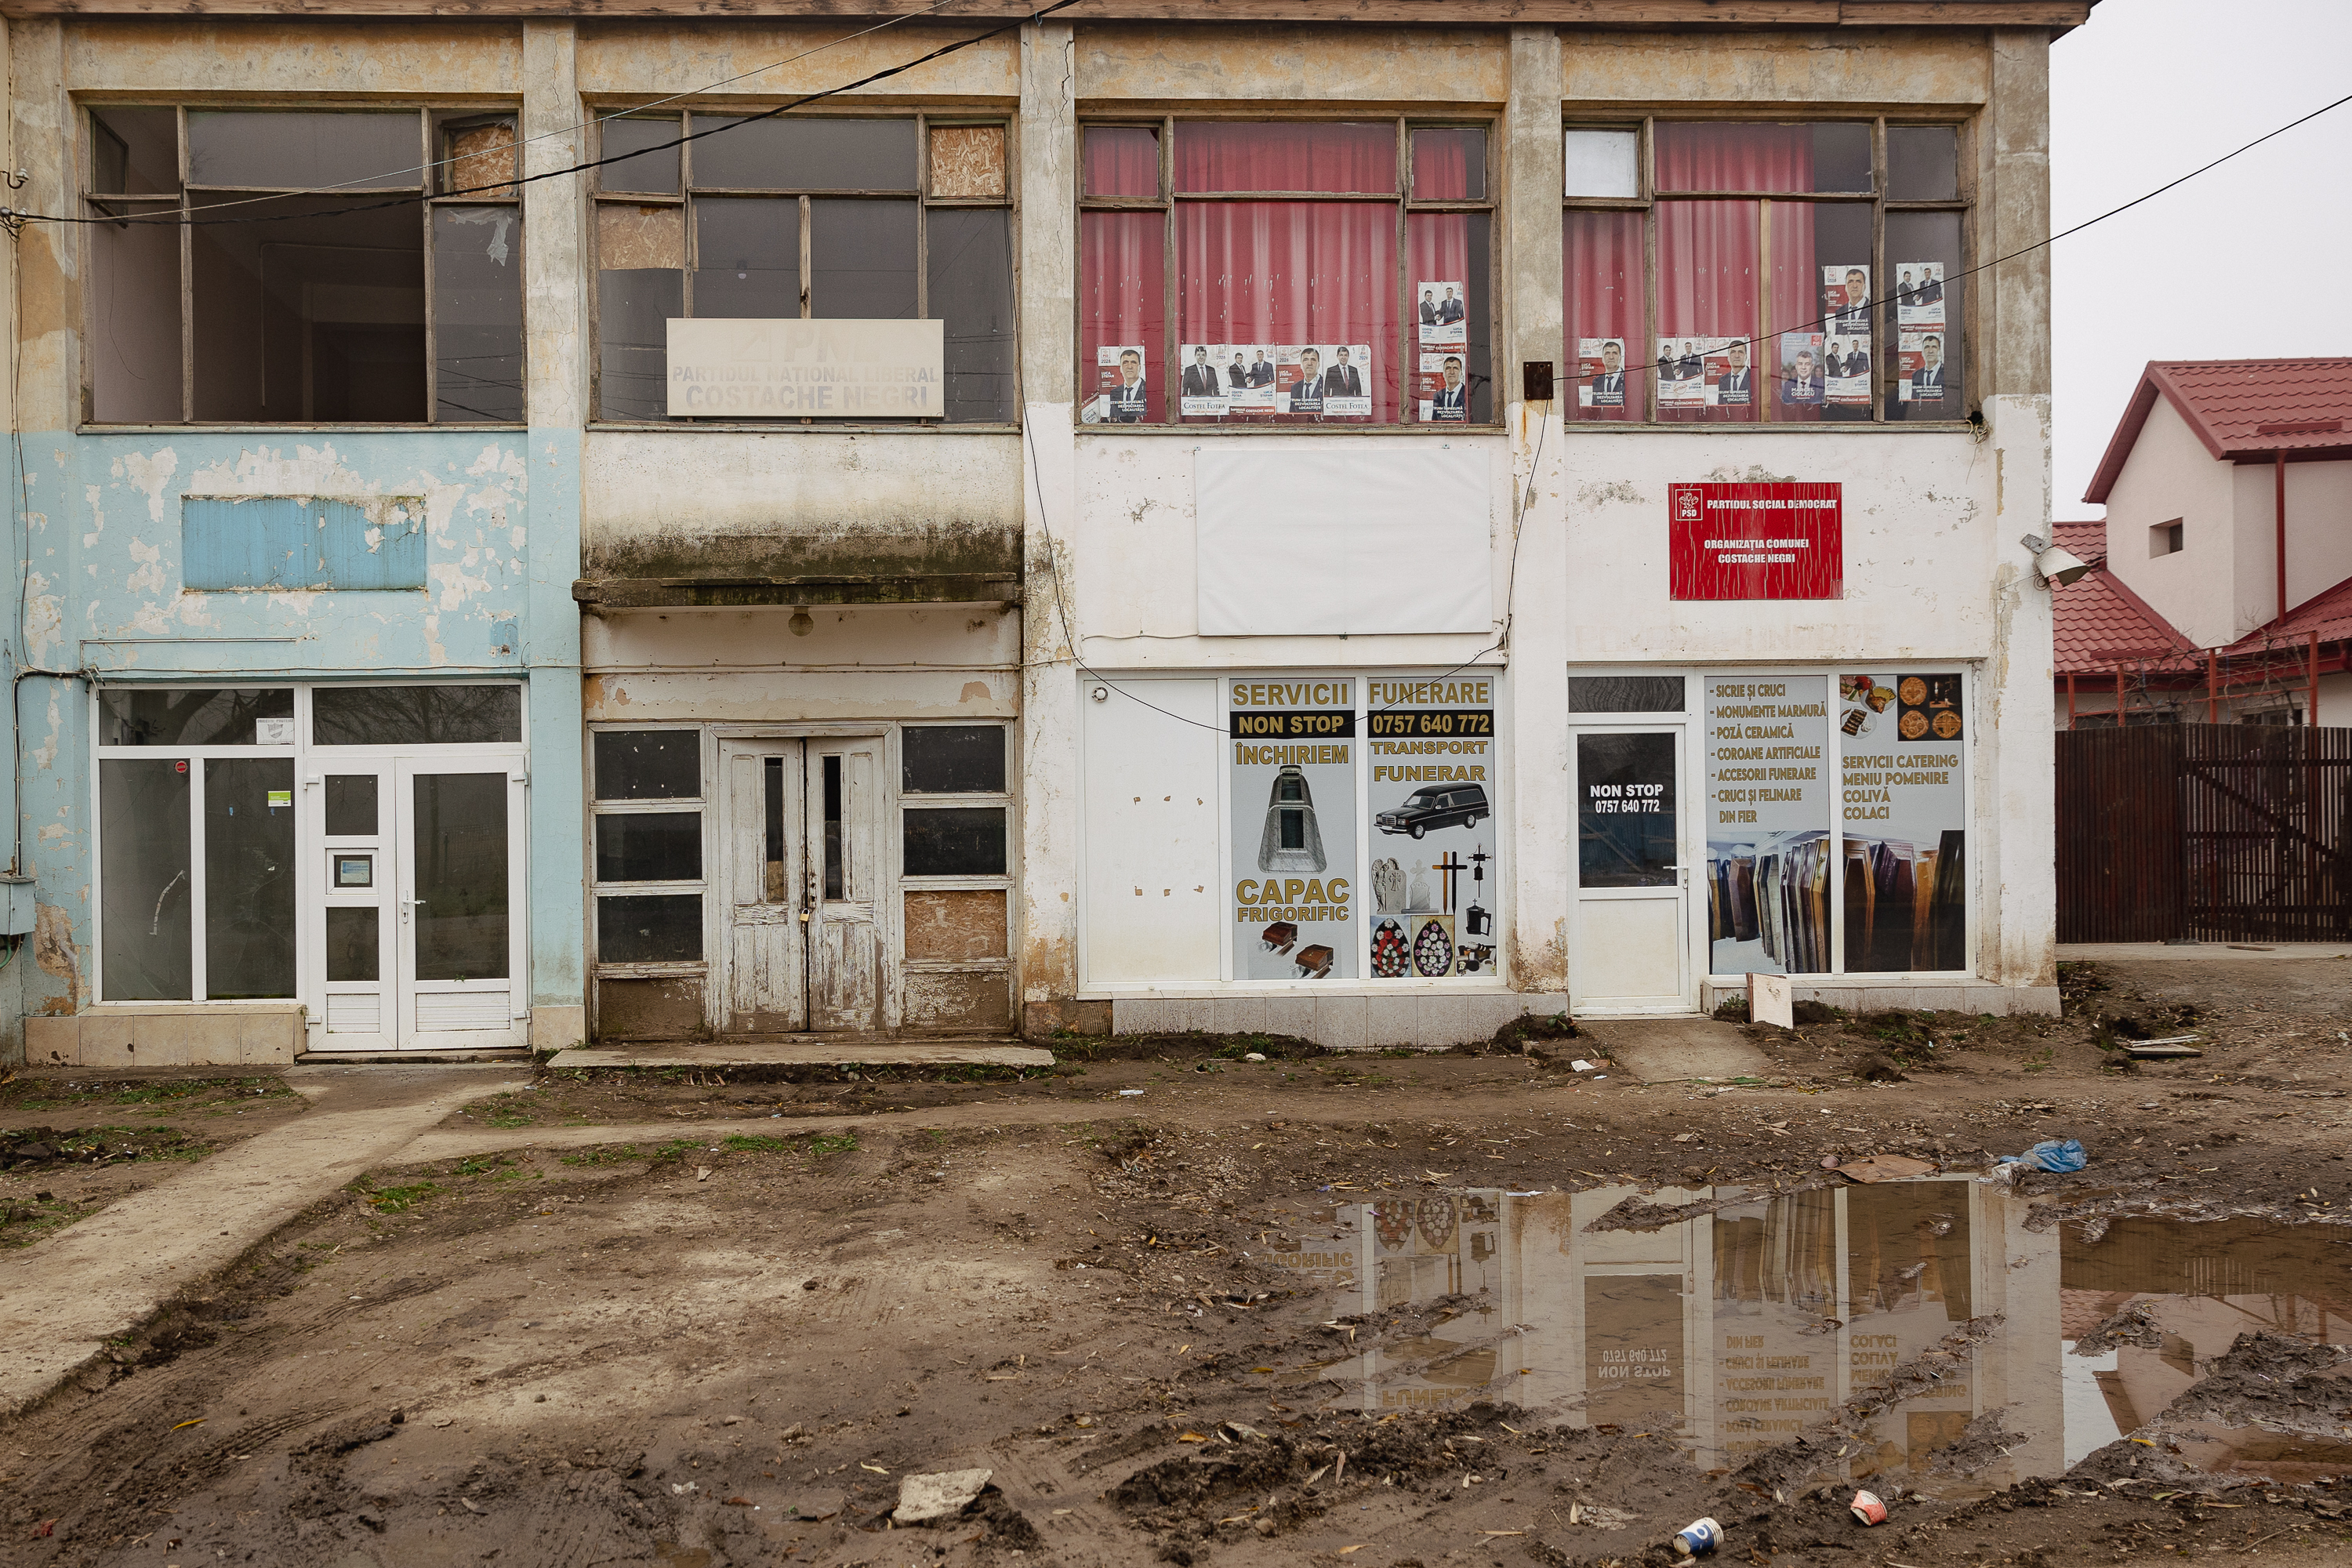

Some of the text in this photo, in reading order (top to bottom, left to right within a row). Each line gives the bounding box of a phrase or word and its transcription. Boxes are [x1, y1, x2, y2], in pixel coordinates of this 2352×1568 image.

[673, 366, 758, 383] PARTIDUL
[865, 366, 939, 383] LIBERAL
[686, 385, 927, 409] COSTACHE NEGRI
[1707, 499, 1837, 510] PARTIDUL SOCIAL DEMOCRAT
[1704, 539, 1809, 551] ORGANIZAȚIA COMUNEI
[1718, 554, 1795, 564] COSTACHE NEGRI
[1232, 682, 1490, 706] SERVICII FUNERARE
[1716, 684, 1786, 701] SICRIE ȘI CRUCI
[1716, 701, 1827, 718] MONUMENTE MARMURĂ
[1239, 716, 1345, 734] NON STOP
[1373, 714, 1490, 733] 0757 640 772
[1717, 723, 1794, 739] POZĂ CERAMICĂ
[1235, 742, 1349, 765] ÎNCHIRIEM
[1370, 741, 1488, 755] TRANSPORT
[1717, 746, 1820, 760] COROANE ARTIFICIALE
[1842, 754, 1958, 768] SERVICII CATERING
[1374, 765, 1487, 782] FUNERAR
[1718, 767, 1817, 781] ACCESORII FUNERARE
[1842, 771, 1949, 786] MENIU POMENIRE
[1590, 784, 1664, 797] NON STOP
[1718, 788, 1802, 806] CRUCI ȘI FELINARE
[1842, 786, 1891, 803] COLIVĂ
[1595, 799, 1660, 813] 0757 640 772
[1842, 807, 1889, 820] COLACI
[1719, 810, 1757, 823] DIN FIER
[1236, 877, 1350, 906] CAPAC
[1237, 906, 1350, 923] FRIGORIFIC
